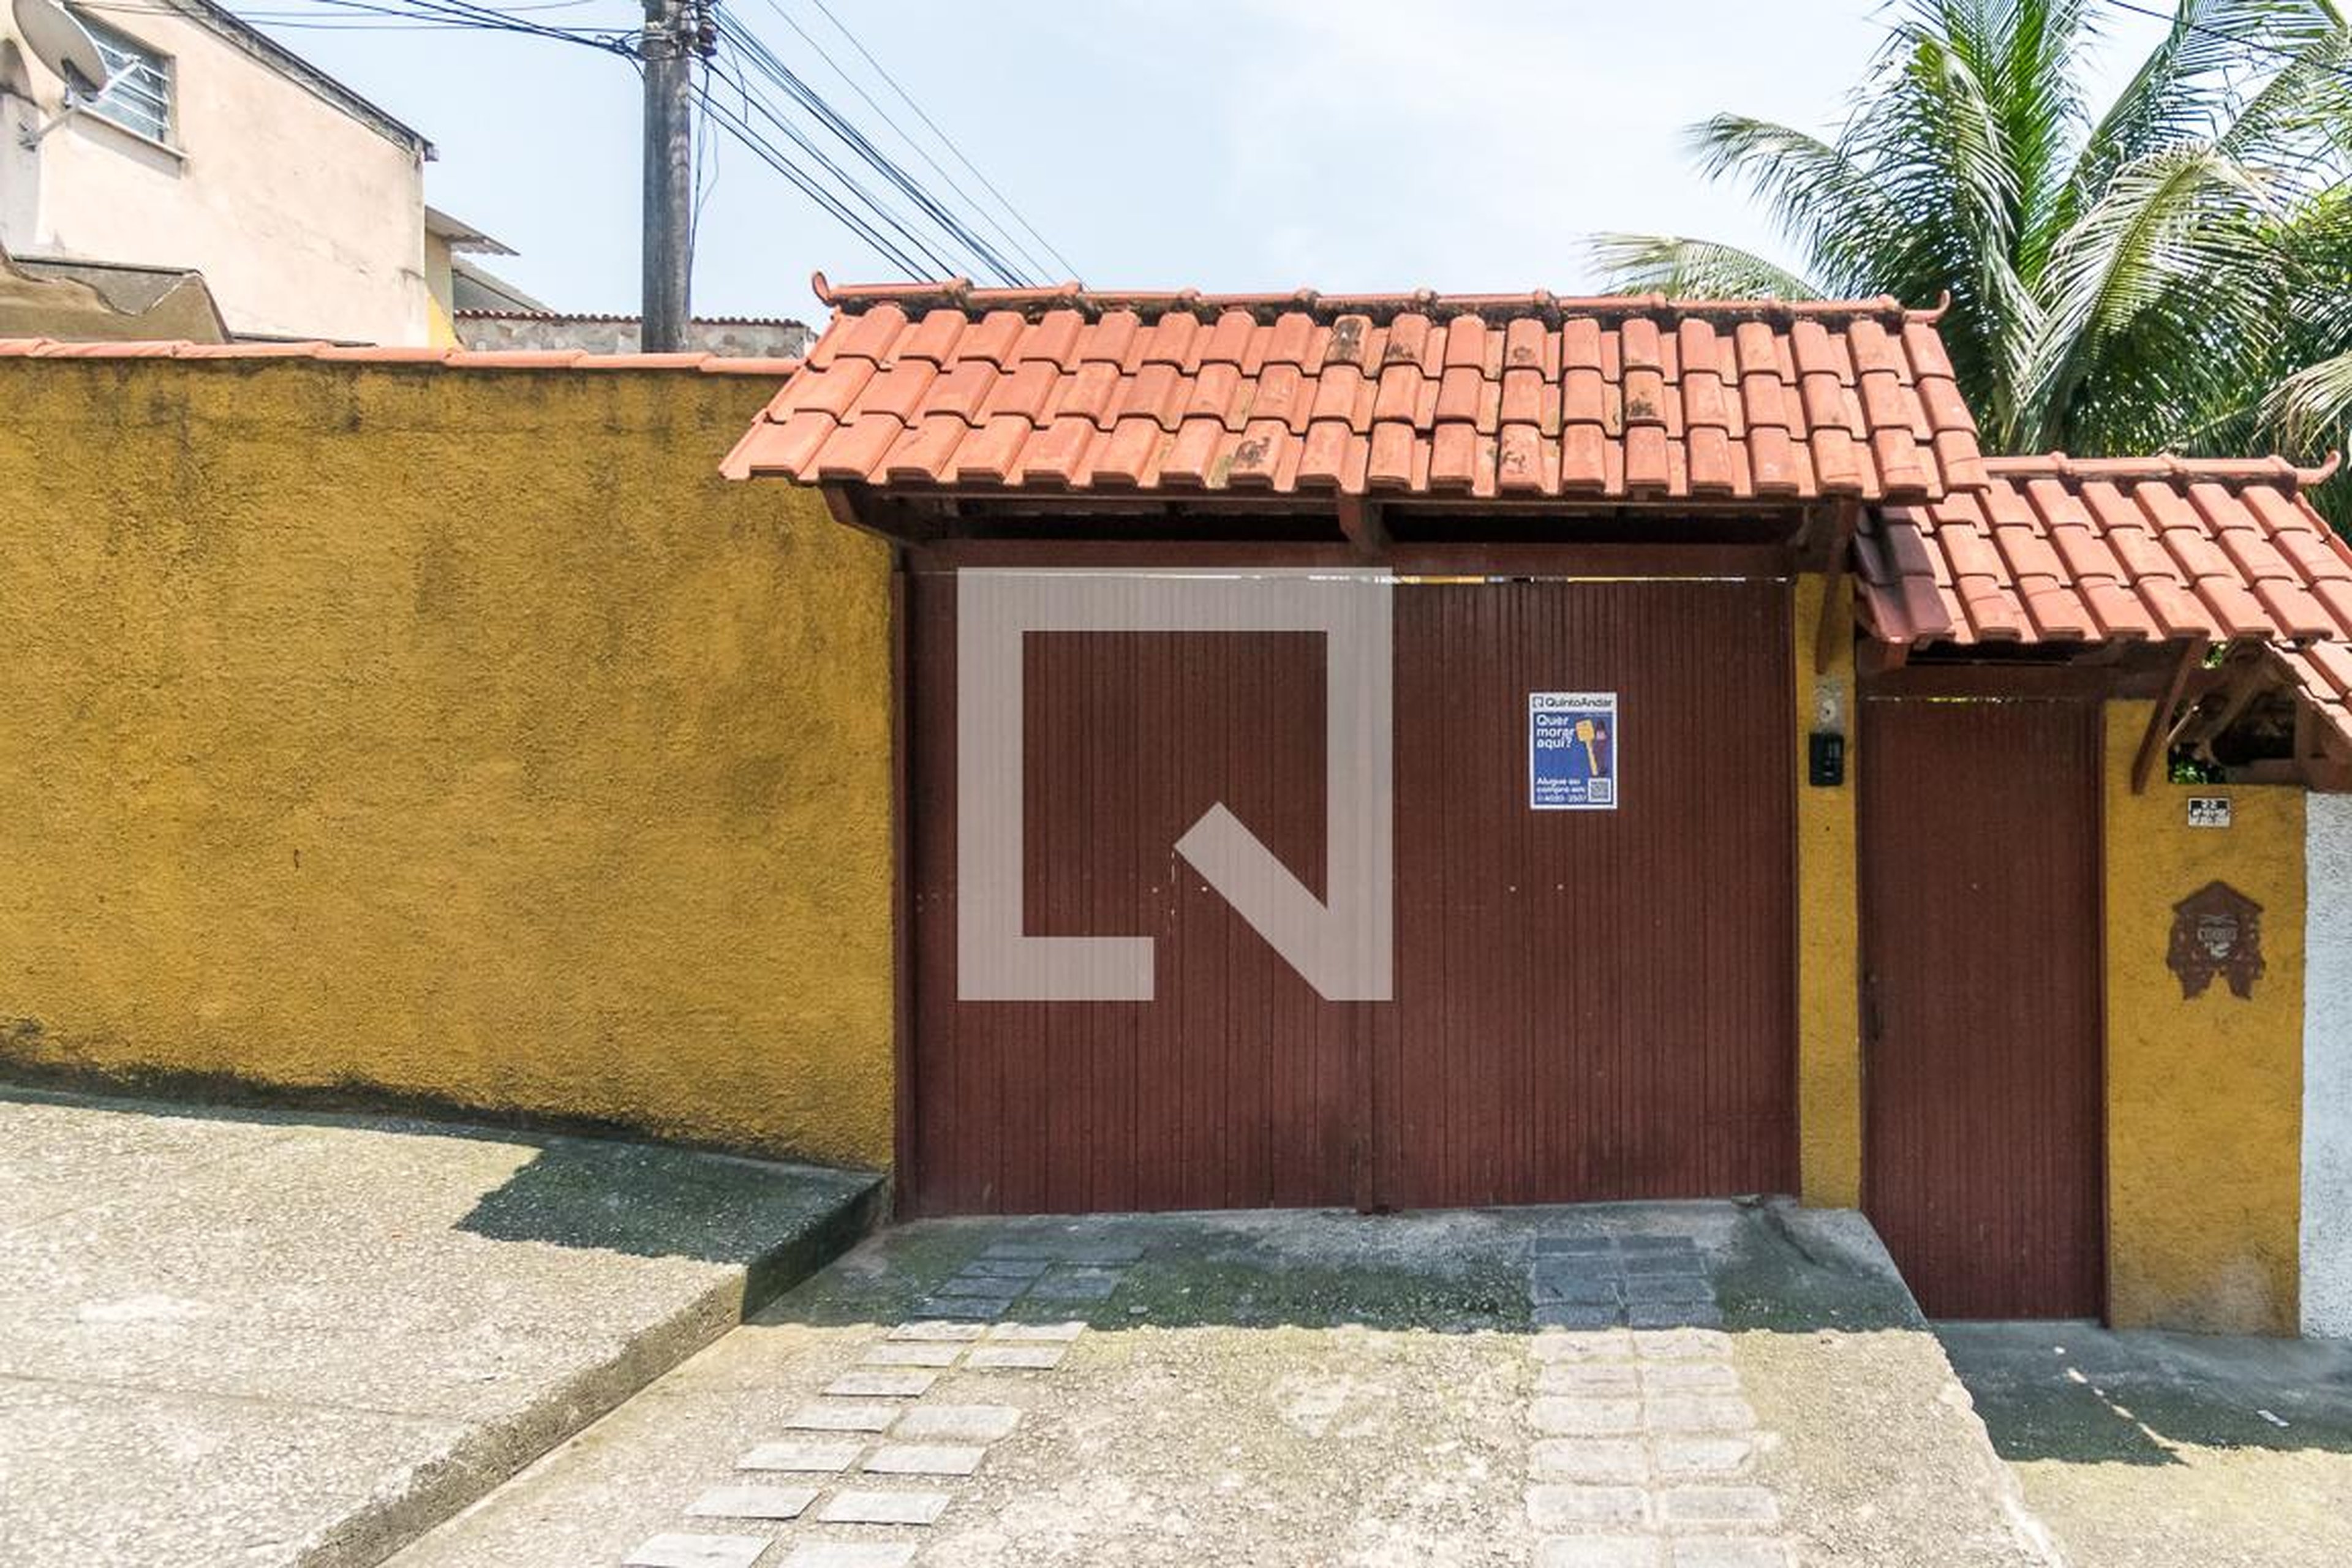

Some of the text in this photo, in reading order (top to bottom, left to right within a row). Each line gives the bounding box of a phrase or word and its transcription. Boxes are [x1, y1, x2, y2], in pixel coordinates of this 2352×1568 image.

[1545, 696, 1613, 707] QuintoAndar
[1536, 714, 1569, 726] Quer
[1536, 728, 1575, 737] morar
[1536, 737, 1572, 750] aqui?
